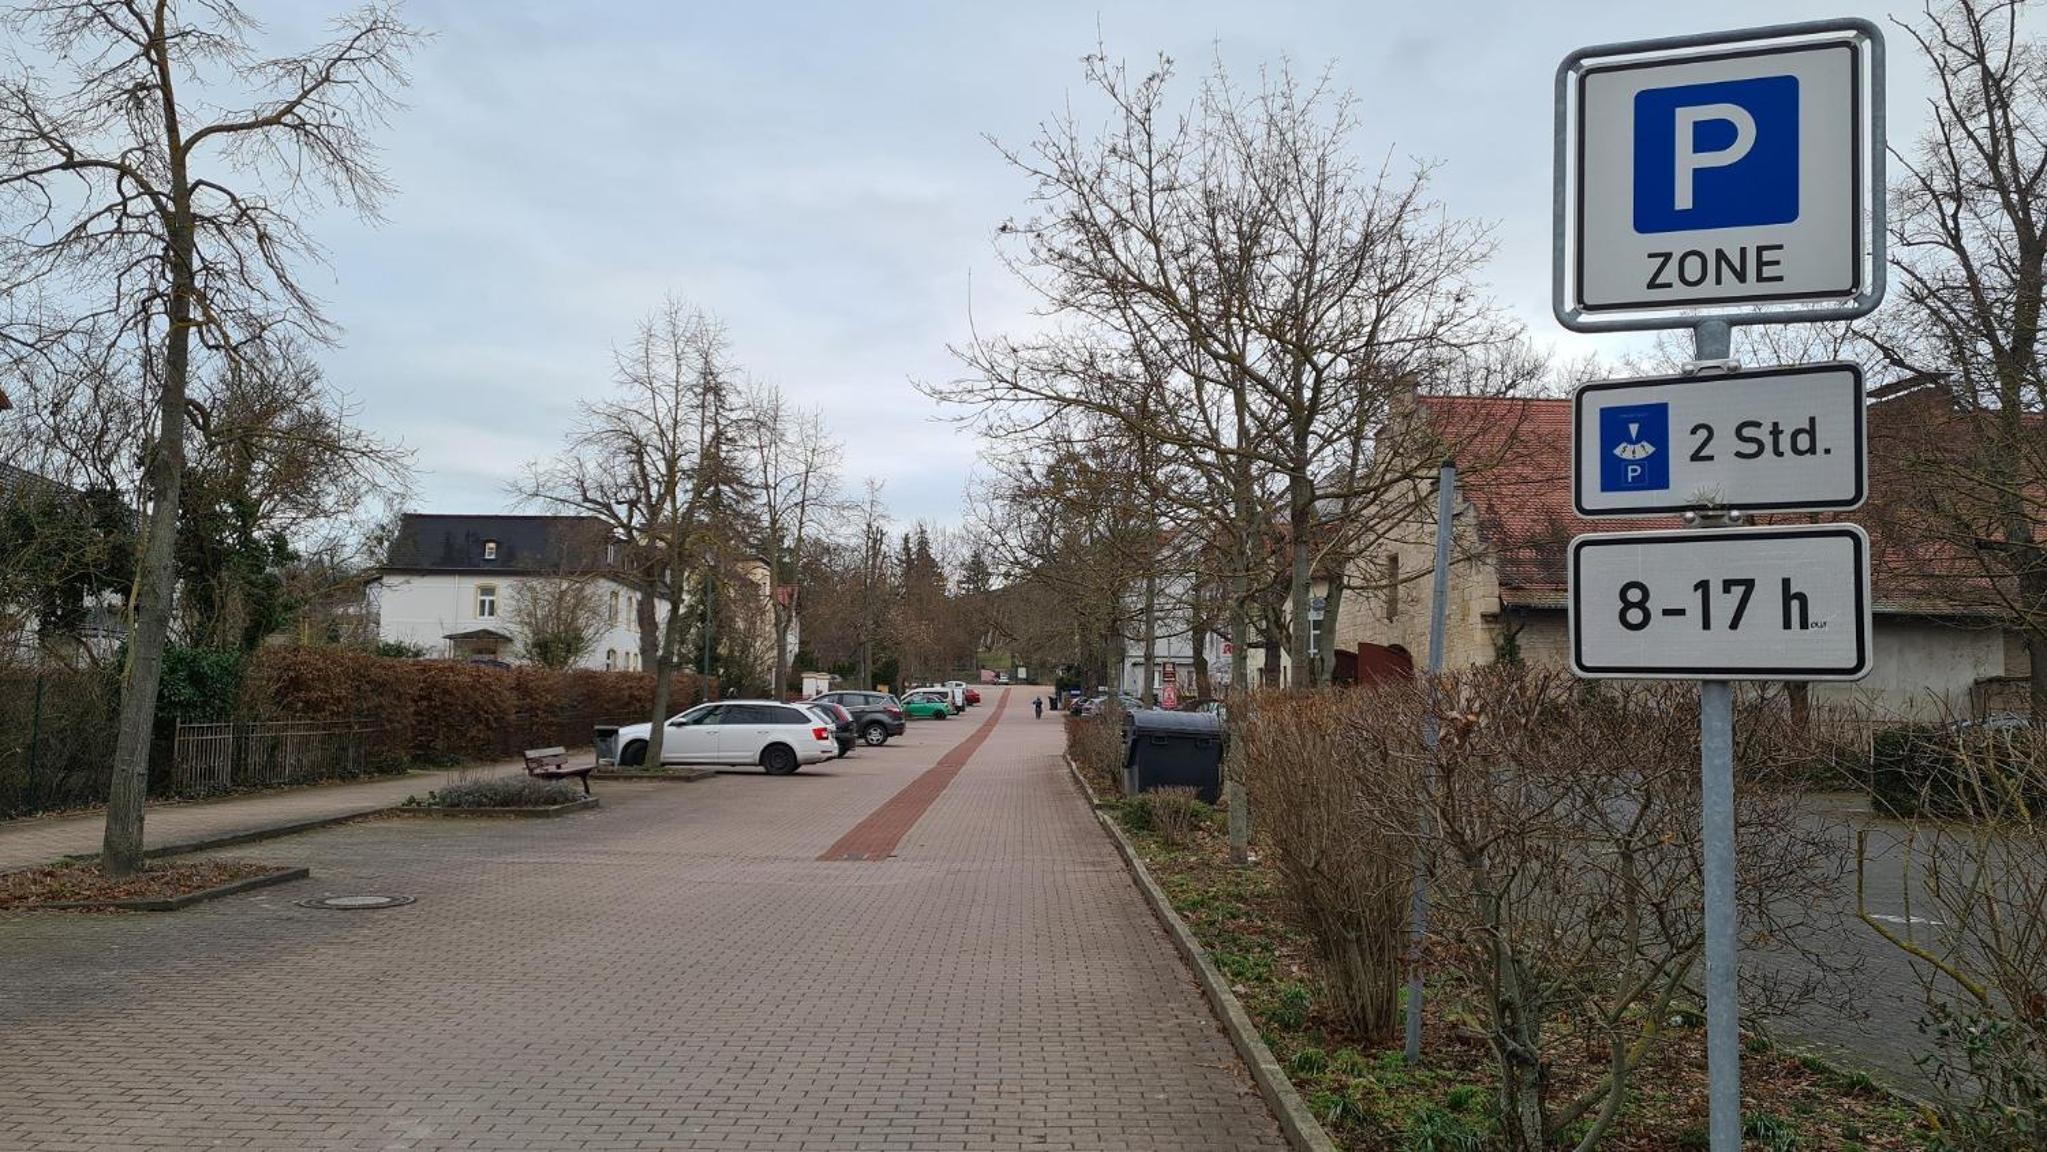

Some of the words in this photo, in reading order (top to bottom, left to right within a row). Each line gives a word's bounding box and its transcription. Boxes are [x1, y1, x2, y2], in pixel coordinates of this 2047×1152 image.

[1674, 103, 1757, 211] P
[1646, 243, 1784, 290] ZONE
[1689, 423, 1715, 462] 2
[1733, 416, 1831, 460] Std.
[1627, 465, 1642, 482] P
[1618, 578, 1756, 631] 8-17
[1781, 577, 1810, 630] h
